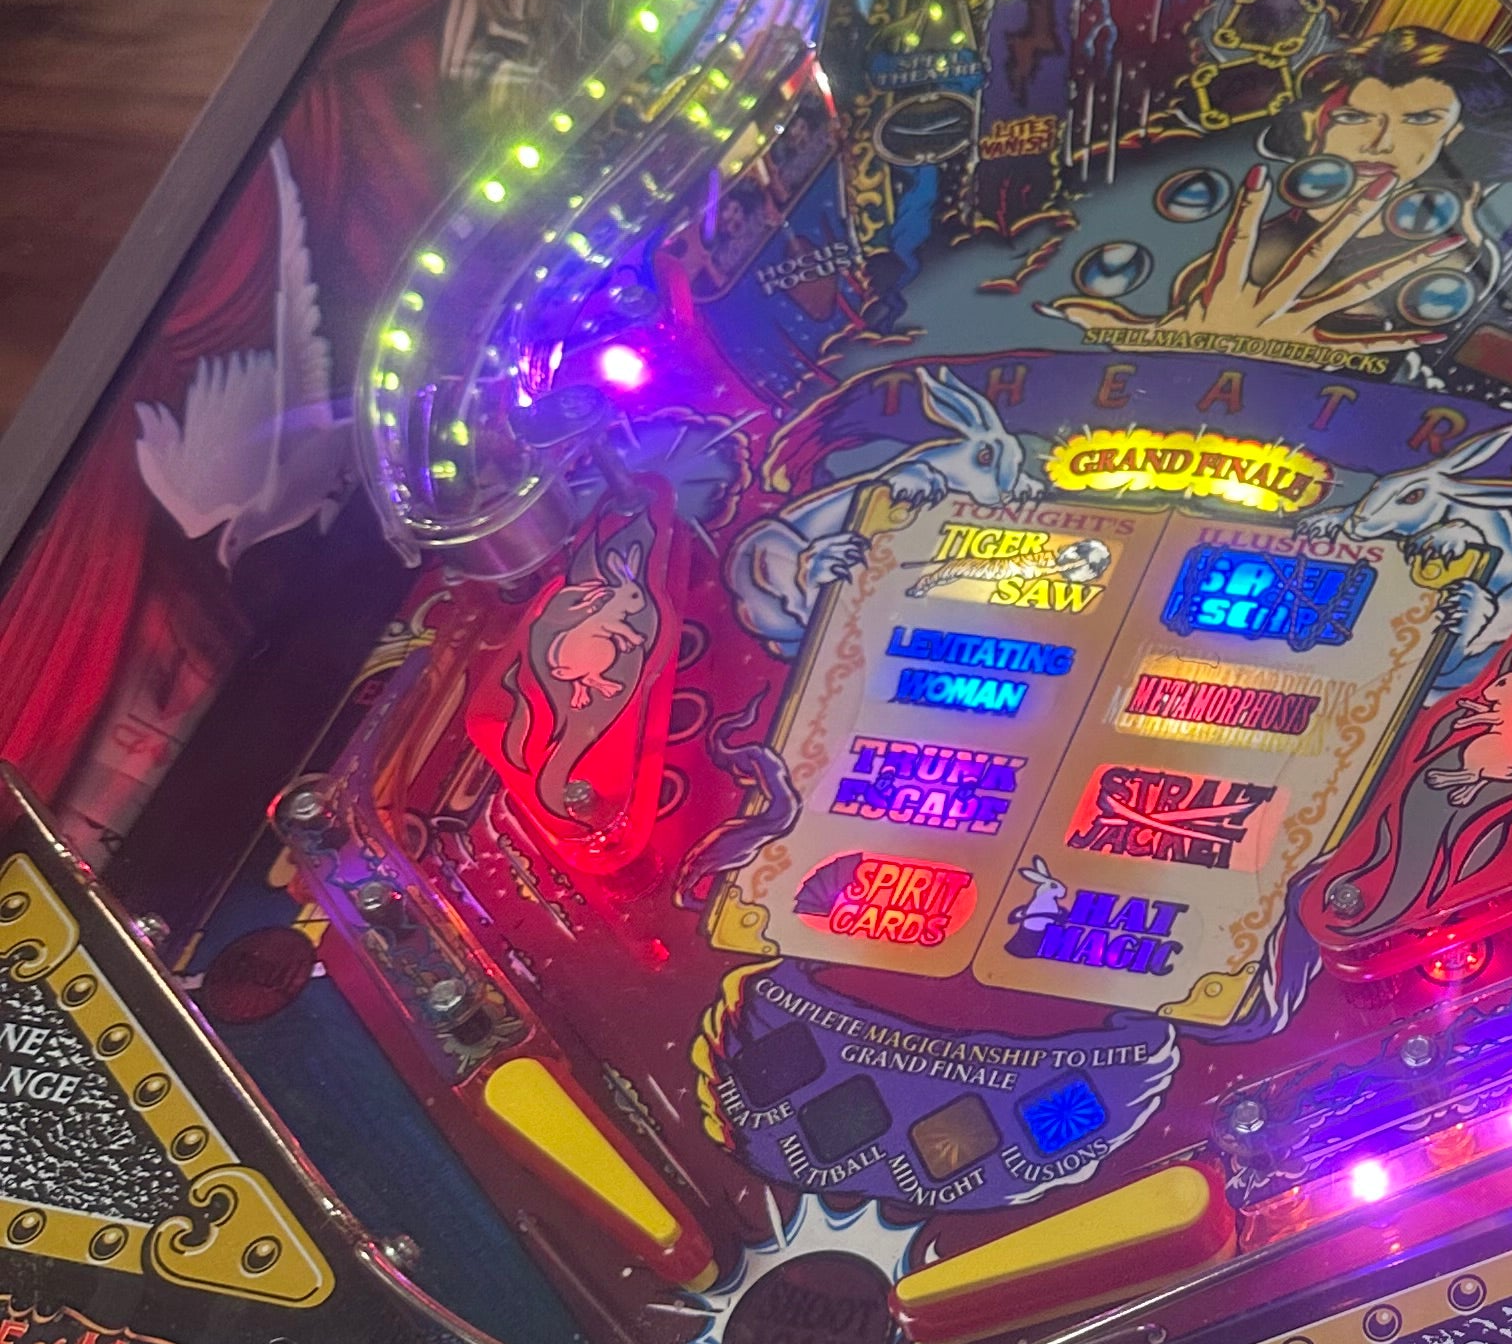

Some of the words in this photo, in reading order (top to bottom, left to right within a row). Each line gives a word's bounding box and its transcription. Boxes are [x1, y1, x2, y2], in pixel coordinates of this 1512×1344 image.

[978, 134, 1056, 158] VANISH
[990, 116, 1057, 138] LITES
[756, 240, 850, 283] HOCUS
[761, 256, 852, 296] POCUS
[1084, 327, 1149, 347] SPELL
[1150, 328, 1230, 353] MAGIC
[1230, 336, 1267, 356] TO
[1267, 340, 1318, 363] LITE
[1316, 347, 1391, 376] LOCKS
[1068, 446, 1197, 479] GRAND
[1196, 451, 1318, 502] FINALE
[934, 522, 1051, 562] TIGER
[951, 500, 1137, 537] TONIGHT'S
[1198, 526, 1387, 564] ILLUSIONS
[989, 575, 1105, 615] SAW
[886, 625, 1077, 676] LEVITATING
[893, 668, 1030, 717] WOMAN
[1124, 673, 1322, 736] METAMORPHOSIS
[850, 735, 1029, 793] TRUNK
[829, 777, 1012, 836] ESCAPE
[1096, 766, 1278, 826] STRAIT
[1066, 817, 1248, 870] JACKET
[850, 857, 974, 914] SPIRIT
[829, 902, 952, 948] CARDS
[1066, 888, 1190, 938] HAT
[1038, 921, 1184, 977] MAGIC
[754, 975, 867, 1038] COMPLETE
[863, 1023, 1047, 1067] MAGICIANSHIP
[1051, 1049, 1092, 1069] TO
[1093, 1043, 1150, 1067] LITE
[839, 1042, 929, 1076] GRAND
[928, 1059, 1021, 1091] FINALE
[716, 1074, 796, 1131] THEATRE
[779, 1132, 887, 1189] MULTIBALL
[886, 1153, 989, 1208] MIDNIGHT
[999, 1136, 1112, 1184] ILLUSIONS
